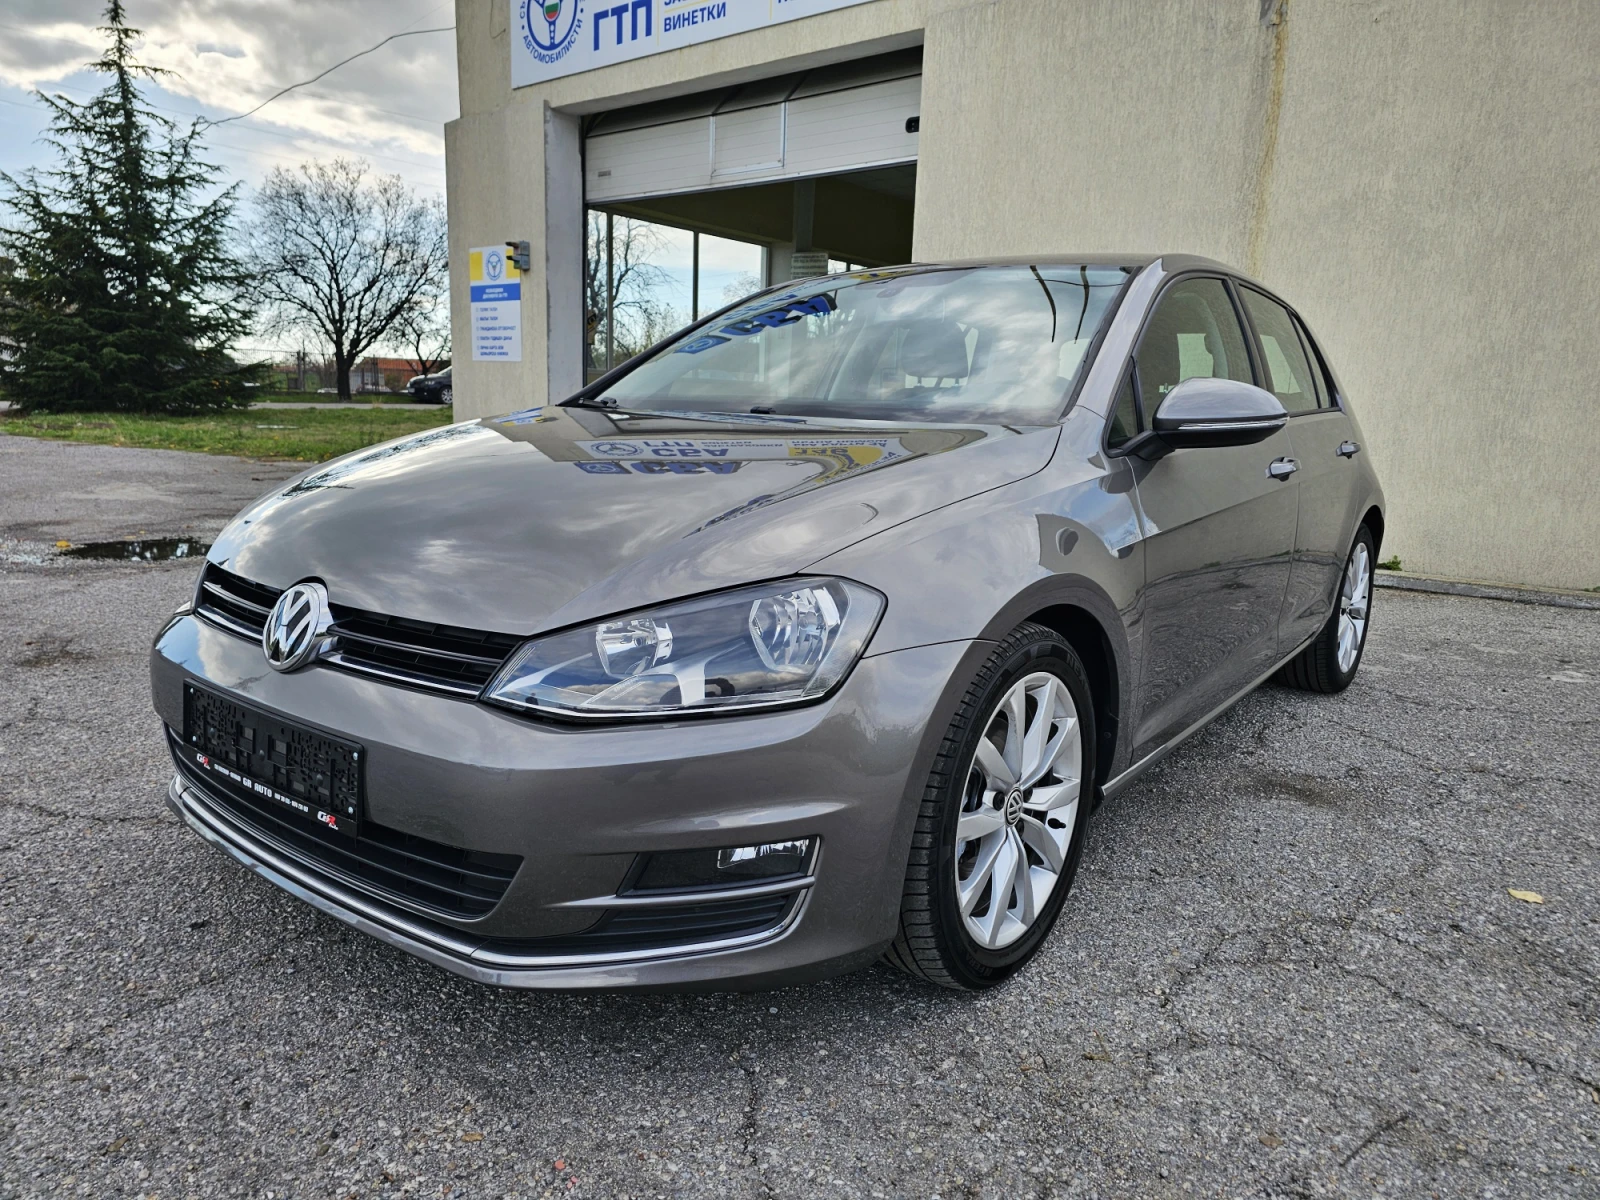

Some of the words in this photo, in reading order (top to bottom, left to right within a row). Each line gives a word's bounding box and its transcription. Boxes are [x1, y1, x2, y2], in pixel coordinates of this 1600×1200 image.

[593, 0, 653, 52] ГТП
[664, 2, 727, 33] ВИНЕТКИ
[523, 18, 583, 64] АВТОМОБИЛИСТИ
[254, 782, 273, 798] AUTO
